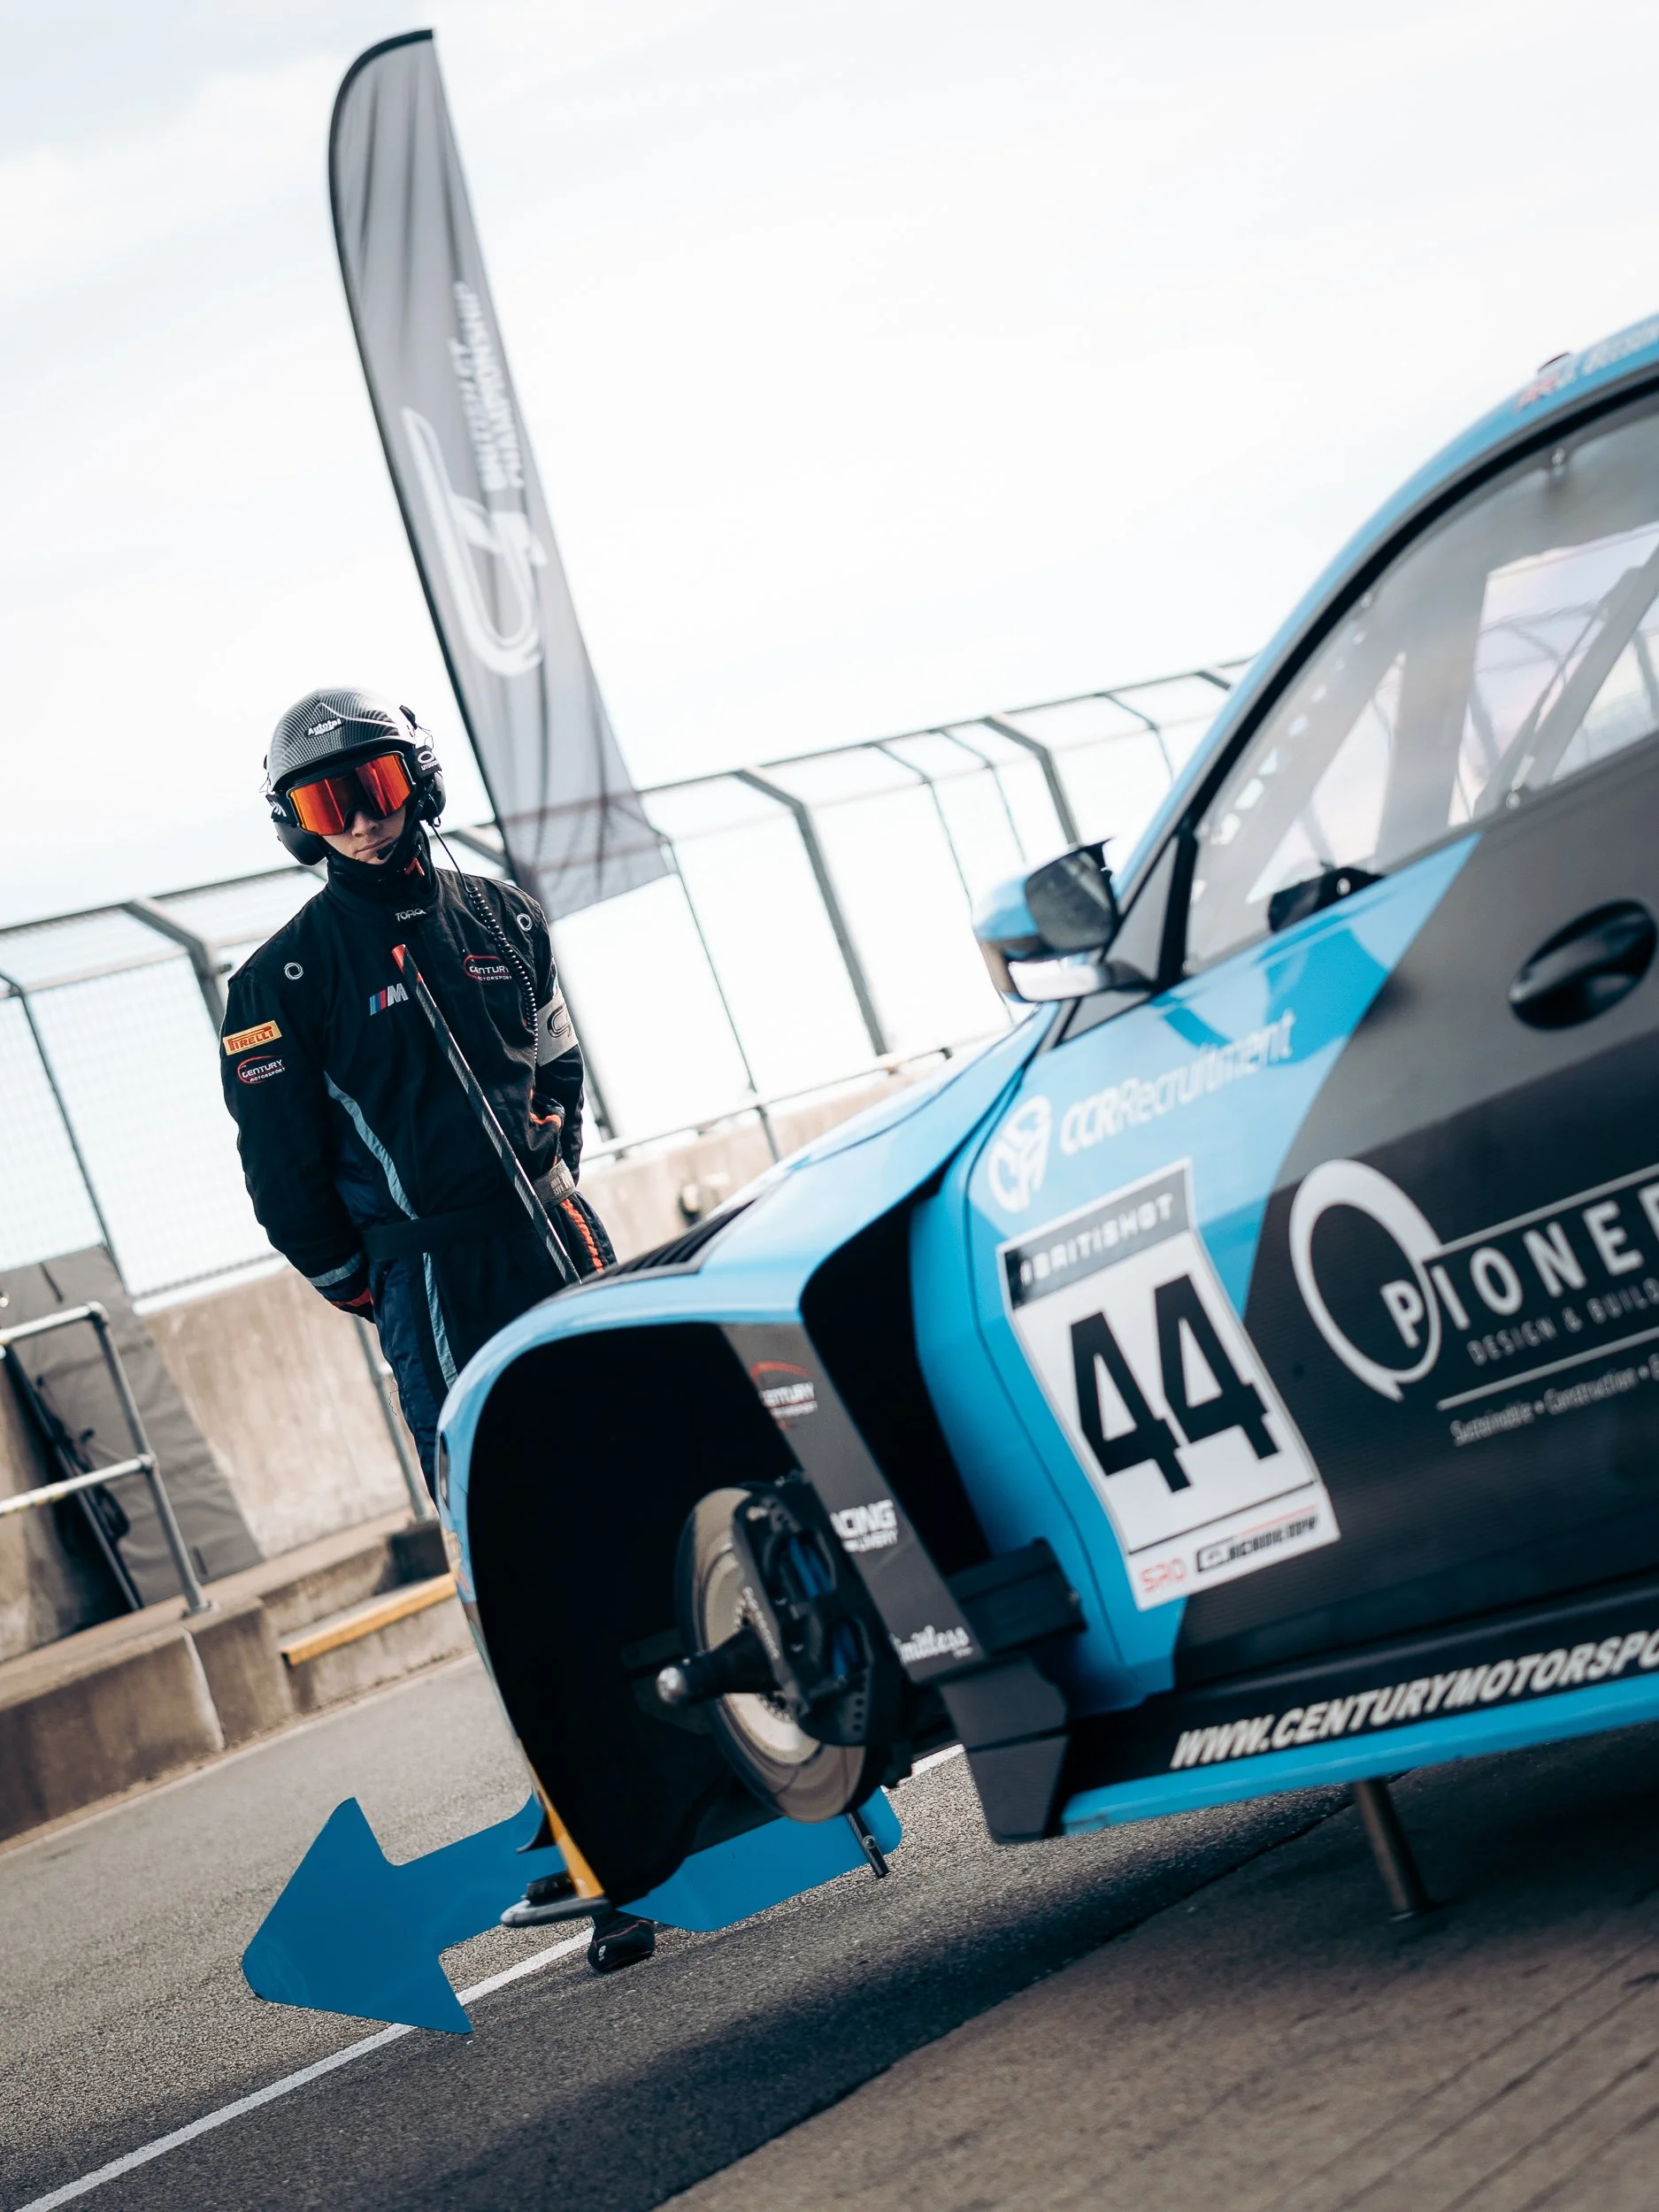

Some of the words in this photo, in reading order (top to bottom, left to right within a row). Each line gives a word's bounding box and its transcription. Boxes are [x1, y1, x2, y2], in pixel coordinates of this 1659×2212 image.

[454, 280, 526, 489] CHAMPIONSHIP
[227, 1025, 274, 1053] PIRELLI
[241, 1059, 282, 1079] CENTURY
[250, 1067, 286, 1083] MOTORSPORT
[1466, 1315, 1558, 1366] DESIGN
[1561, 1305, 1584, 1333] &
[1070, 1273, 1281, 1494] 44
[1543, 1367, 1640, 1416] Construction
